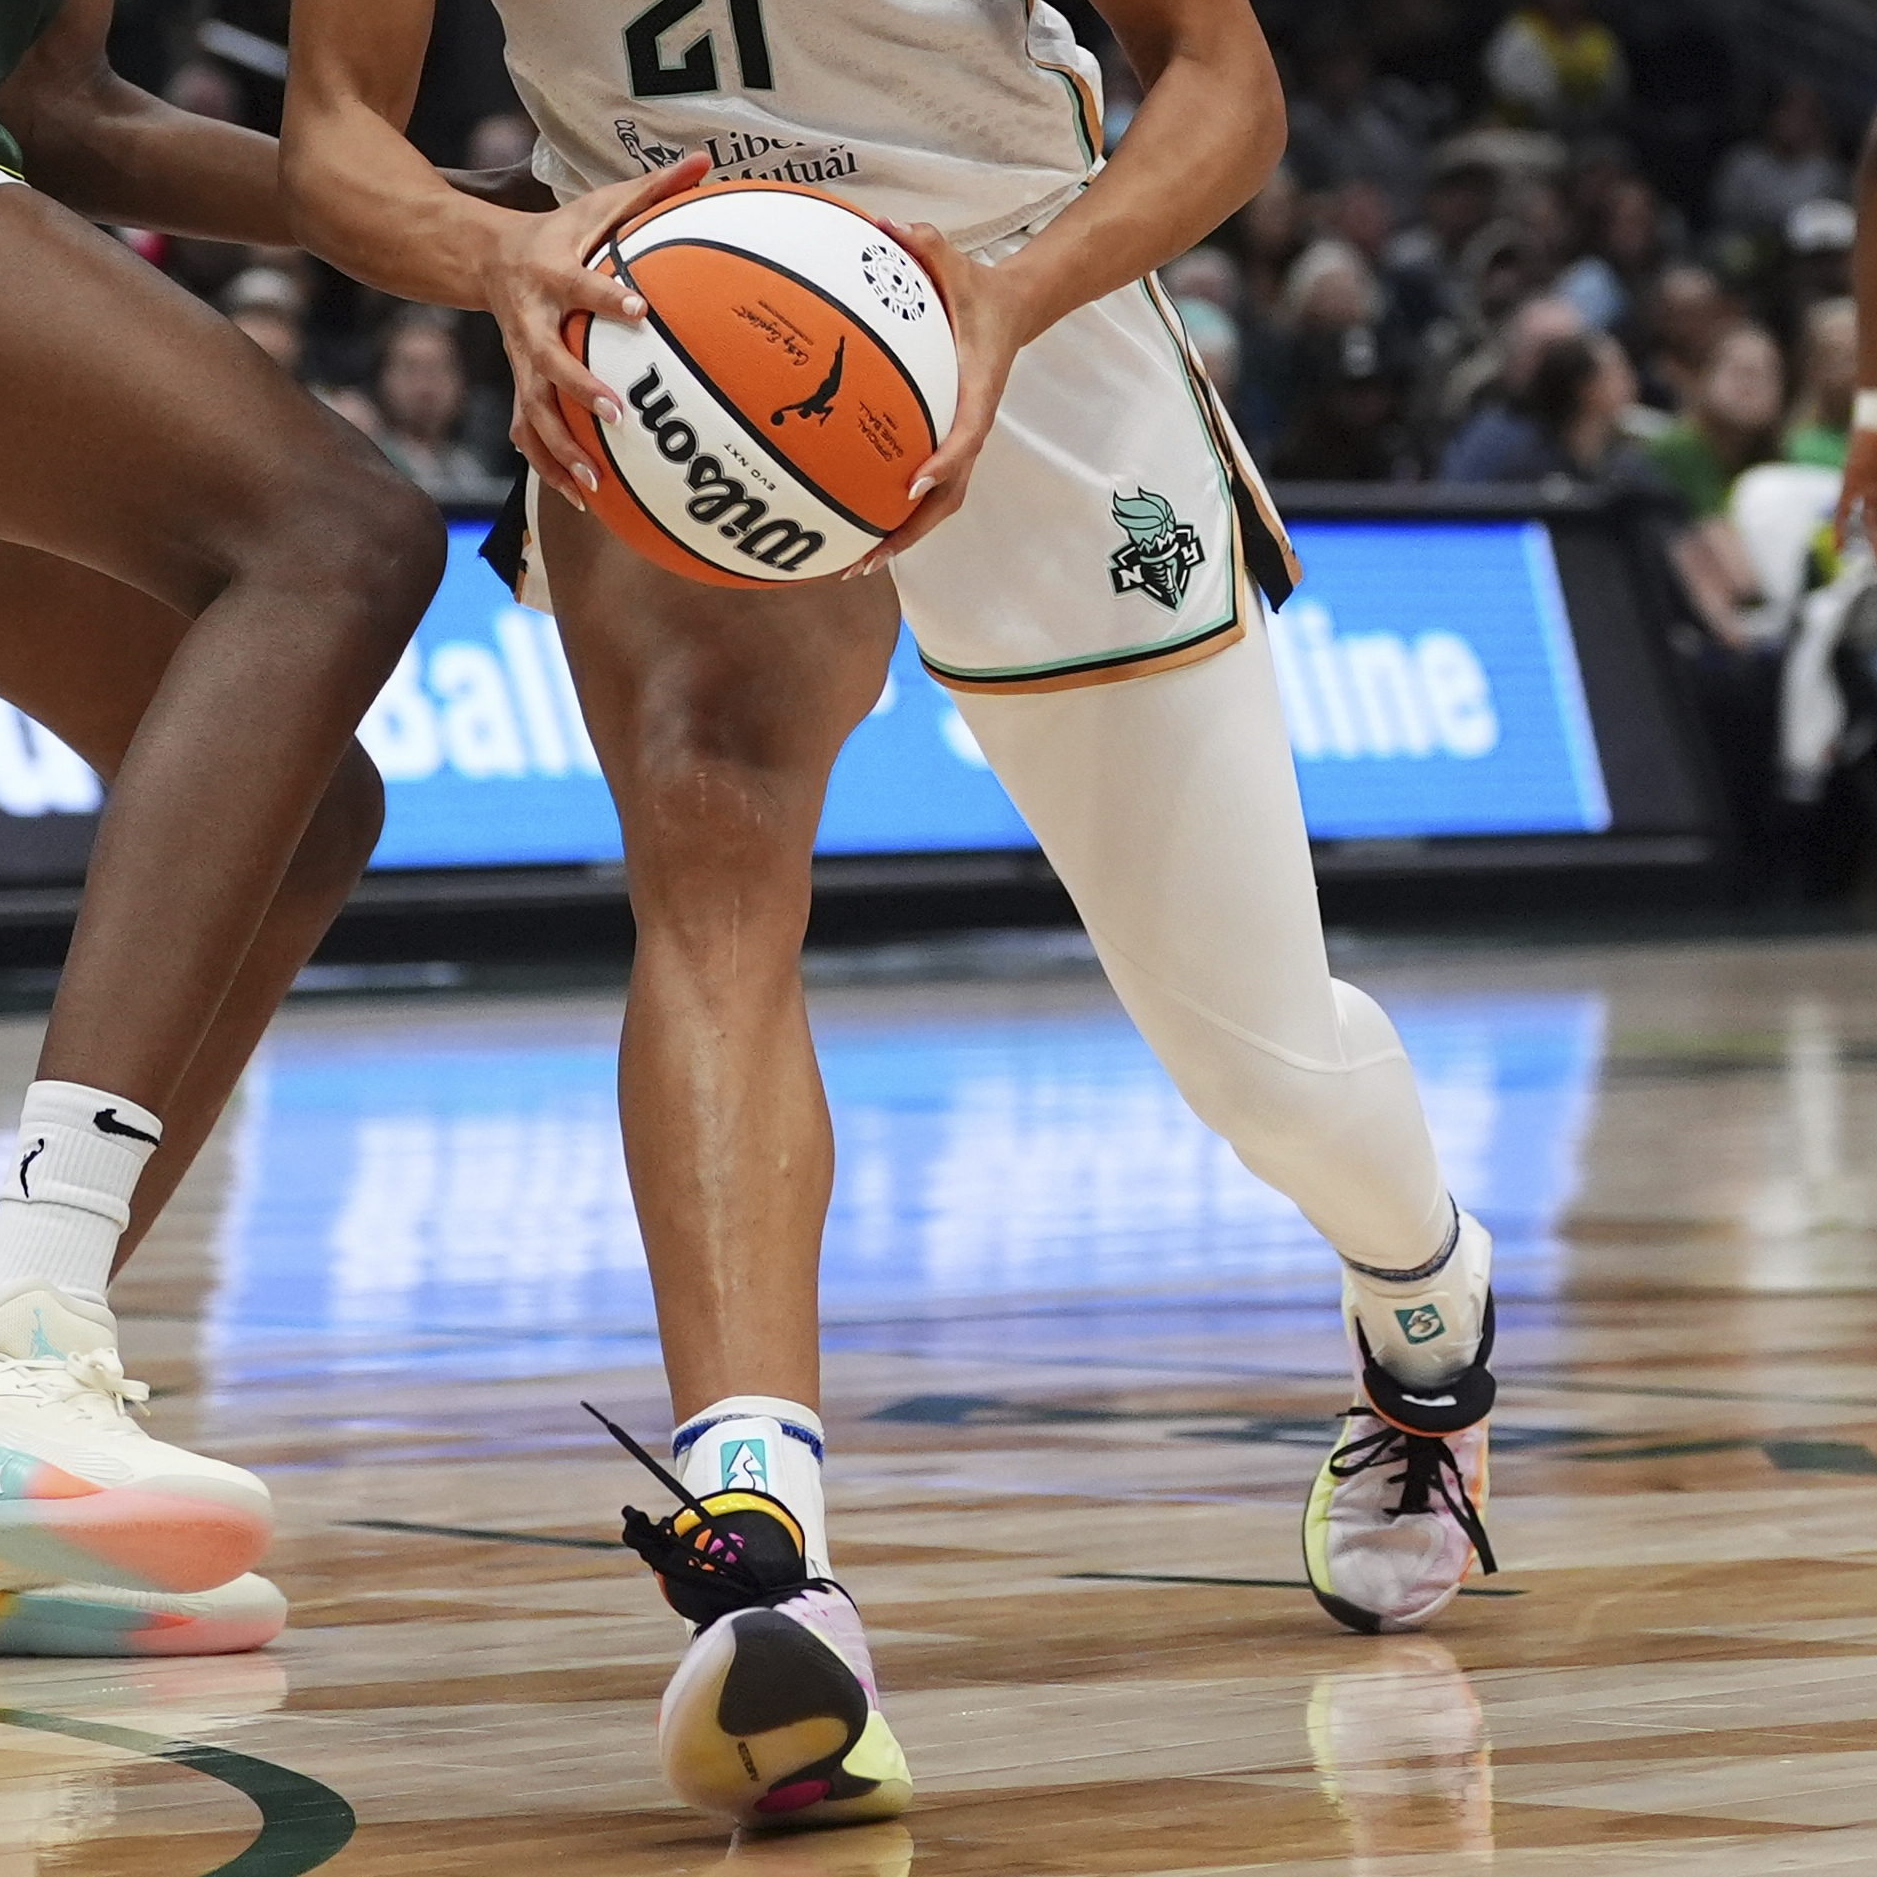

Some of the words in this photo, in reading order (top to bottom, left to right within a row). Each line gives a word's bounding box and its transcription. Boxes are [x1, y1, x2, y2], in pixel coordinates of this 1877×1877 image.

[626, 362, 826, 573] Wilson
[723, 442, 750, 468] NXT
[750, 468, 777, 492] EVO
